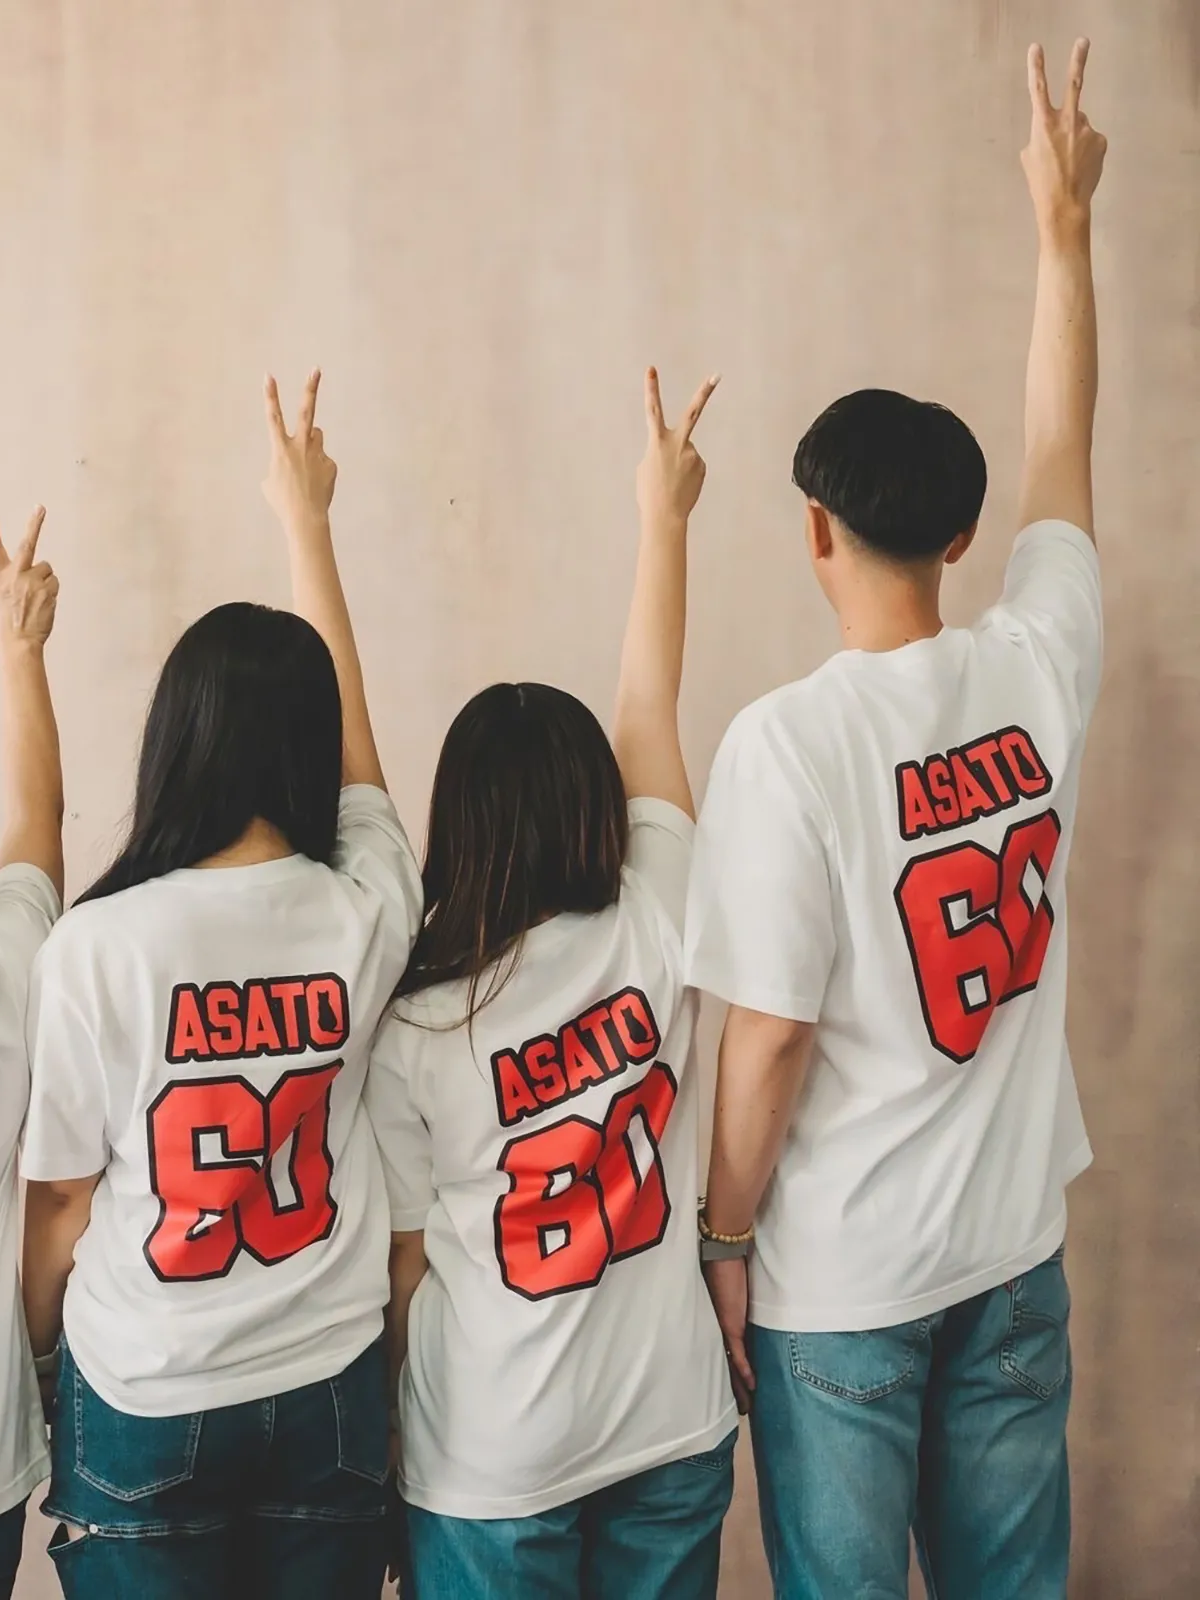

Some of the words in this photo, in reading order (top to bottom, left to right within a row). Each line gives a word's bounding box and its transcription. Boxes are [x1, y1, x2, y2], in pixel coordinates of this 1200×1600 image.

[895, 725, 1053, 841] ASATO
[893, 807, 1062, 1065] 60
[165, 972, 349, 1064] ASATO
[491, 985, 661, 1127] ASATO
[142, 1057, 345, 1282] 60
